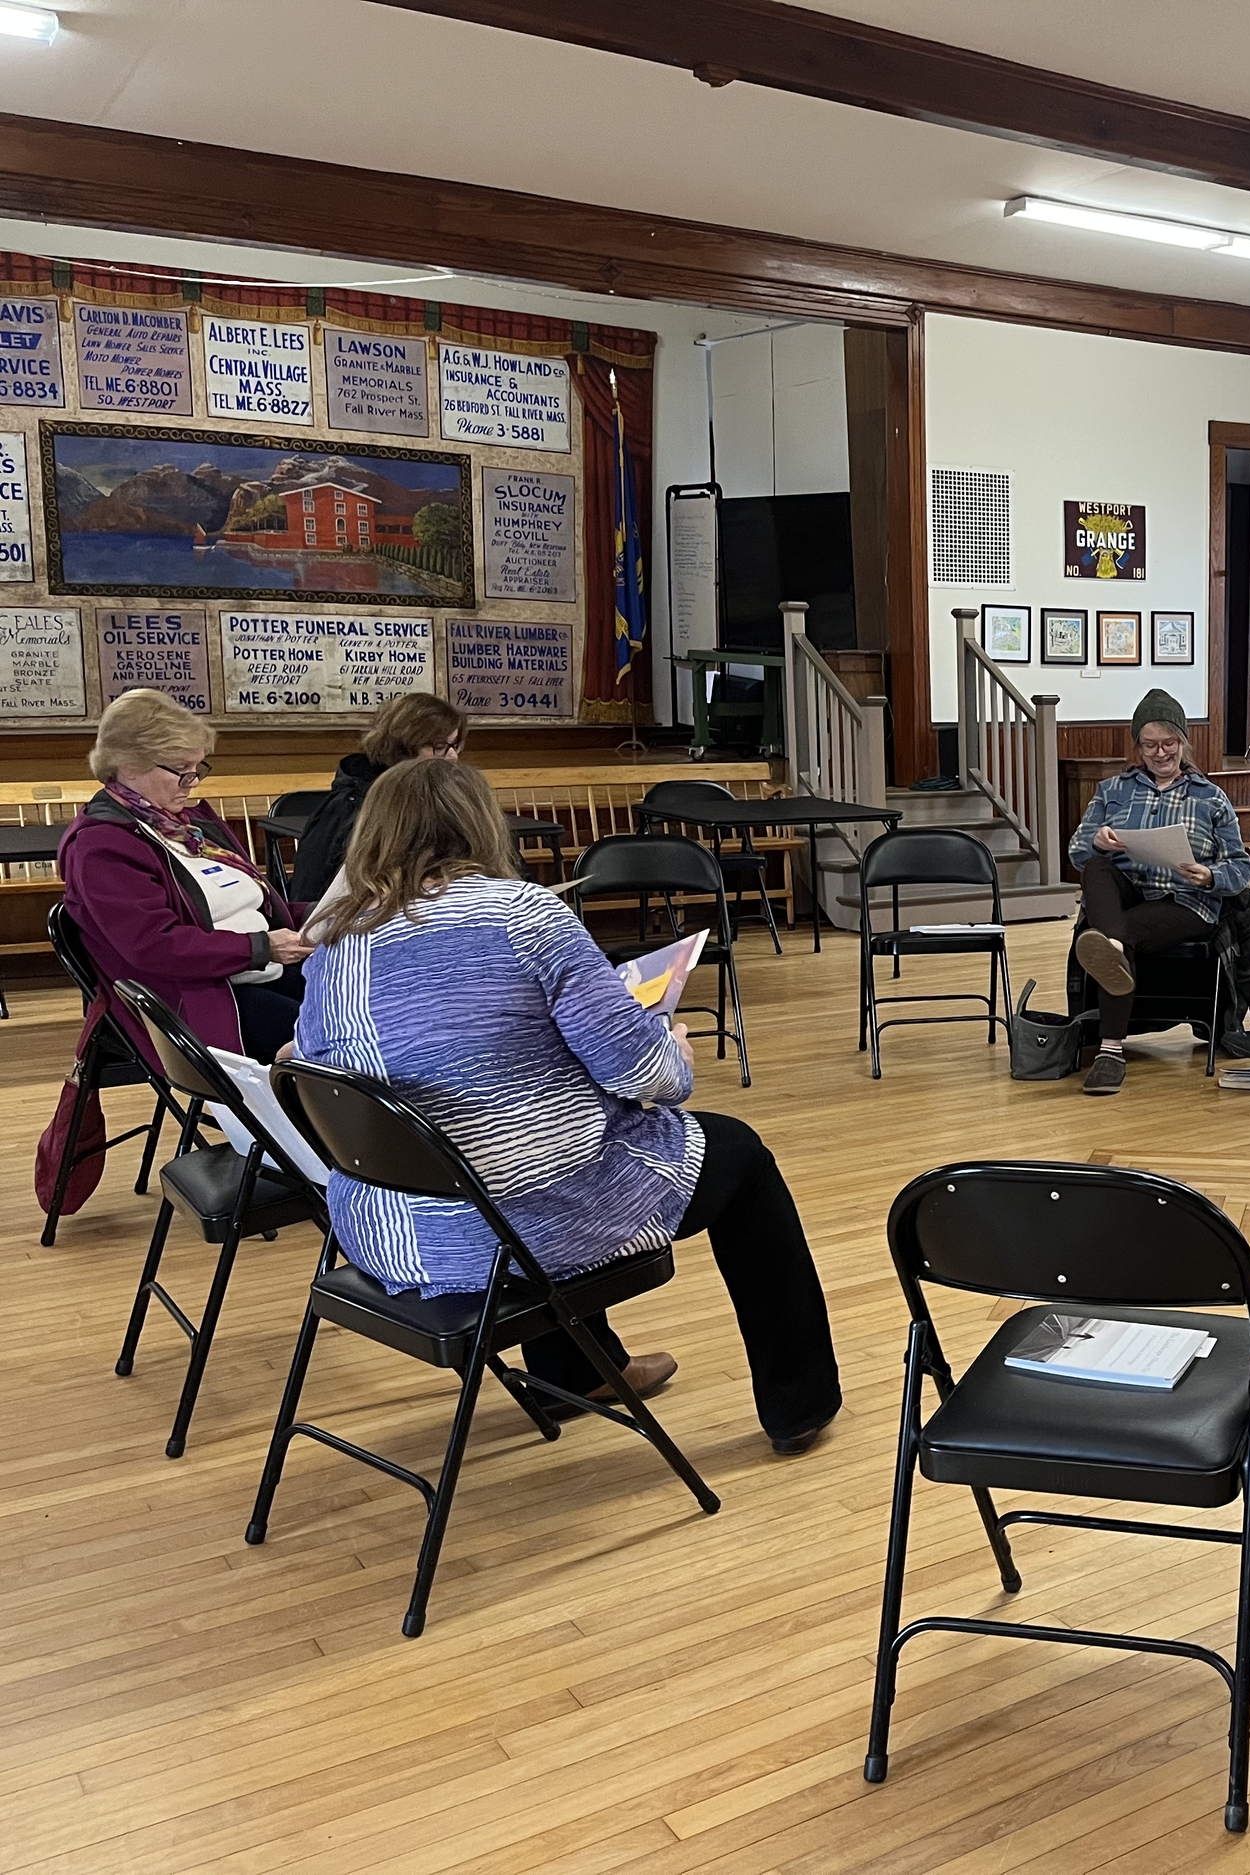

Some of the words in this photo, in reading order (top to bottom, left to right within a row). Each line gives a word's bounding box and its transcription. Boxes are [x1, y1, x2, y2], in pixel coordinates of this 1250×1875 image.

[0, 303, 45, 324] AVIS
[79, 307, 120, 325] CARLTON
[122, 311, 131, 326] D.
[131, 312, 182, 331] MACOMBER
[87, 325, 121, 337] GENERAL
[126, 329, 148, 340] AUTO
[151, 331, 182, 342] REPAIRS
[209, 322, 256, 346] ALBERT
[260, 327, 272, 347] E.
[273, 328, 304, 351] LEES
[82, 338, 101, 348] LAWN
[104, 340, 132, 351] MOWER
[136, 342, 157, 353] SALES
[159, 344, 185, 356] SERVICE
[247, 348, 271, 356] INC.
[338, 336, 406, 360] LAWSON
[84, 351, 109, 362] MOTO
[110, 354, 142, 365] MOWER
[494, 354, 552, 377] HOWLAND
[120, 365, 152, 377] POWER
[153, 368, 184, 379] MOWERS
[209, 354, 261, 379] CENTRAL
[262, 360, 308, 383] VILLAGE
[334, 356, 379, 372] GRANITE
[386, 361, 422, 376] MARBLE
[83, 375, 104, 391] TEL.
[106, 377, 124, 392] ME.
[342, 375, 413, 392] MEMORIALS
[446, 369, 502, 388] INSURANCE
[509, 377, 518, 390] &
[239, 378, 286, 398] MASS.
[97, 394, 115, 406] SO.
[117, 396, 176, 410] WESTPORT
[212, 393, 234, 410] TEL.
[236, 395, 256, 412] ME.
[337, 388, 357, 399] 762
[361, 390, 404, 404] Prospect
[408, 395, 421, 406] St.
[486, 388, 560, 409] ACCOUNTANTS
[345, 403, 363, 414] Fall
[400, 408, 426, 421] Mass.
[444, 398, 456, 411] 26
[457, 400, 489, 416] BEDFORD
[505, 405, 520, 419] FALL
[522, 407, 544, 422] RIVER
[546, 410, 567, 424] MASS.
[457, 417, 495, 436] Phone
[508, 475, 534, 484] FRANK
[494, 485, 567, 506] SLOCUM
[499, 500, 565, 515] INSURANCE
[1078, 502, 1132, 516] WESTPORT
[494, 517, 562, 532] HUMPHREY
[503, 529, 549, 542] COVILL
[1076, 529, 1136, 550] GRANGE
[505, 556, 557, 567] AUCTIONEER
[1066, 565, 1082, 576] NO.
[1133, 567, 1144, 579] 181
[503, 575, 550, 586] APPRAISER
[14, 614, 64, 631] EALES
[111, 615, 182, 631] LEES
[230, 616, 290, 635] POTTER
[295, 620, 369, 637] FUNERAL
[374, 622, 428, 638] SERVICE
[0, 628, 71, 645] Memorials
[104, 631, 133, 645] OIL
[136, 631, 200, 645] SERVICE
[235, 634, 275, 643] JONATHAN
[284, 635, 319, 644] POTTER
[450, 623, 473, 638] FALL
[475, 624, 511, 640] RIVER
[514, 625, 558, 642] LUMBER
[339, 639, 374, 648] KENNETH
[384, 640, 418, 649] POTTER
[452, 642, 501, 657] LUMBER
[506, 643, 568, 658] HARDWARE
[116, 650, 191, 661] KEROSENE
[233, 646, 286, 662] POTTER
[288, 648, 323, 661] HOME
[345, 649, 384, 662] KIRBY
[389, 650, 426, 663] HOME
[12, 660, 60, 668] MARBLE
[117, 661, 192, 671] GASOLINE
[247, 663, 277, 674] REED
[282, 664, 308, 674] ROAD
[381, 666, 397, 675] HILL
[400, 666, 424, 675] ROAD
[452, 656, 503, 669] BUILDING
[507, 657, 568, 672] MATERIALS
[13, 669, 57, 677] BRONZE
[112, 671, 134, 681] AND
[137, 671, 171, 681] FUEL
[173, 671, 196, 681] OIL
[250, 675, 302, 685] WESTPORT
[452, 673, 465, 683] 65
[527, 676, 544, 686] FALL
[15, 678, 52, 686] SLATE
[352, 676, 370, 685] NEW
[374, 676, 414, 686] BEDFORD
[167, 685, 192, 693] POINT
[2, 699, 18, 708] FALL
[21, 698, 45, 708] RIVER
[50, 698, 78, 708] MASS.
[239, 691, 264, 705] ME.
[350, 692, 372, 705] N.B.
[456, 688, 492, 707] Phone
[35, 861, 53, 869] Cha
